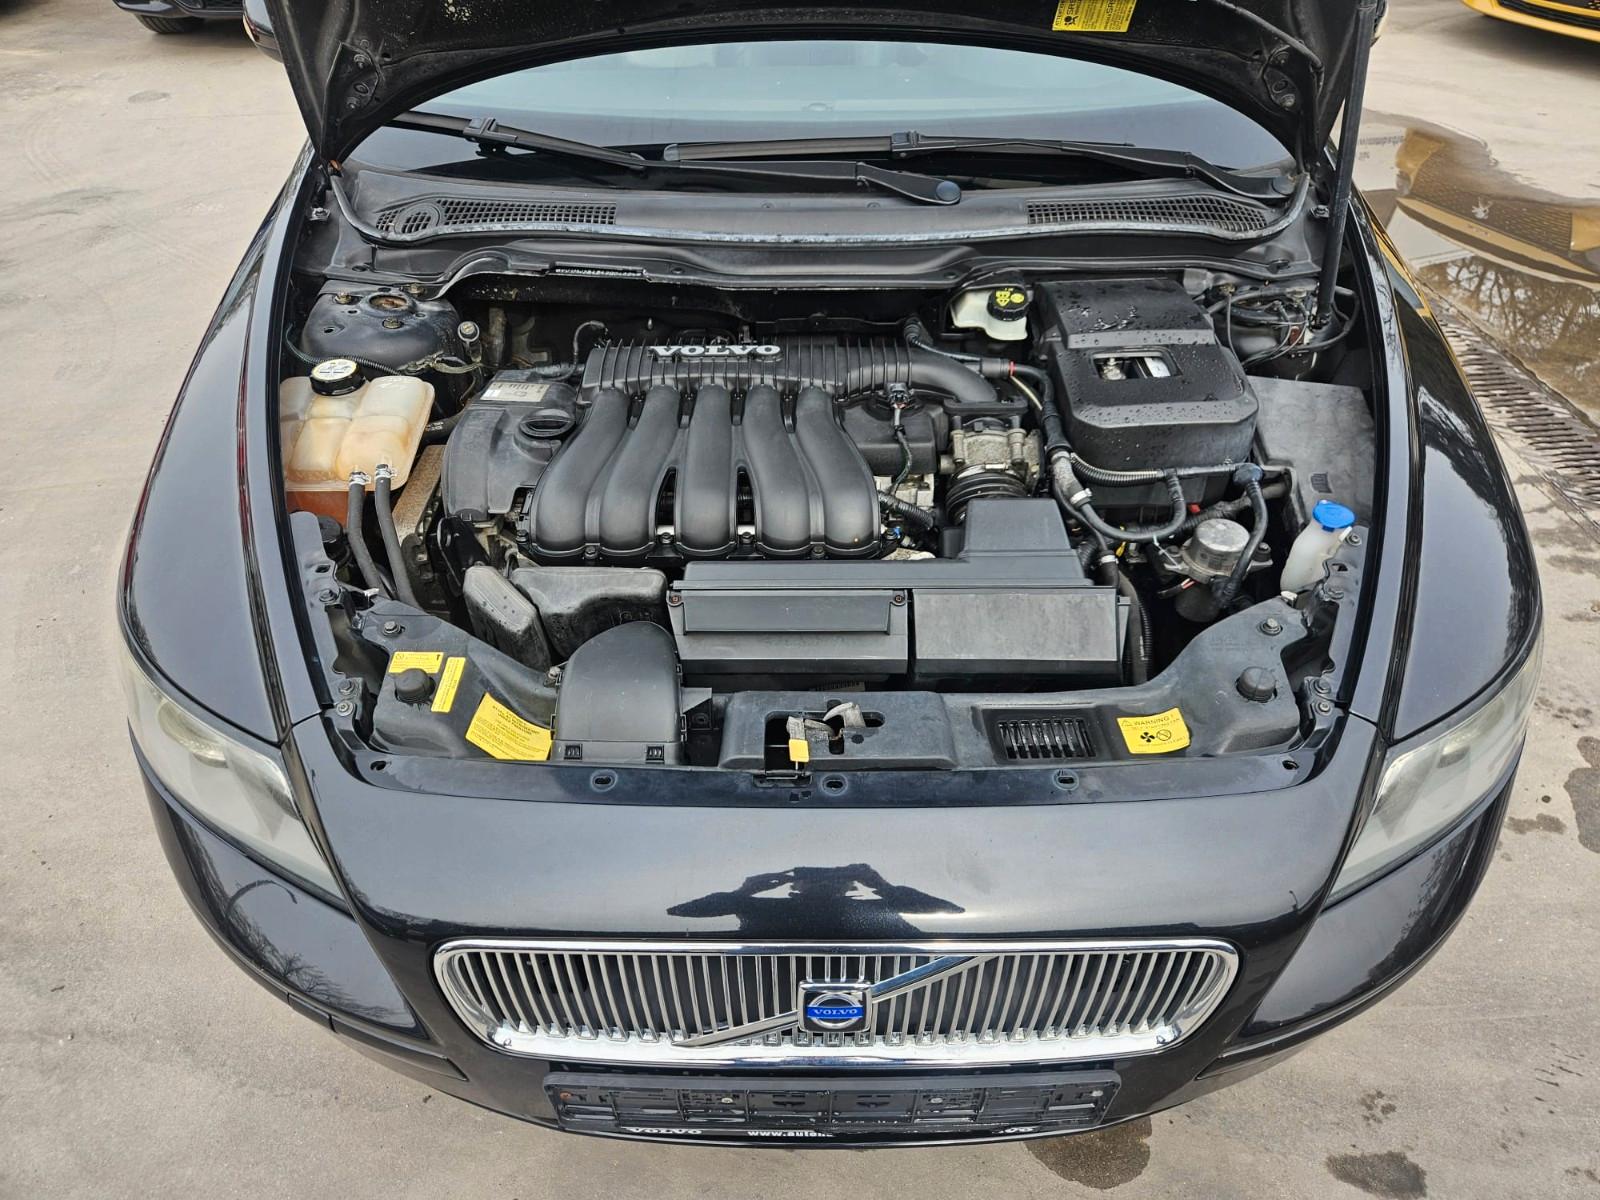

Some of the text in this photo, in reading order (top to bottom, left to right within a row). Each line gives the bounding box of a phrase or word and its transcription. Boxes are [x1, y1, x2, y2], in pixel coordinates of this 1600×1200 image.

[650, 345, 781, 356] VOLVO
[1134, 715, 1170, 726] WARNING
[624, 1127, 702, 1135] VOLVO
